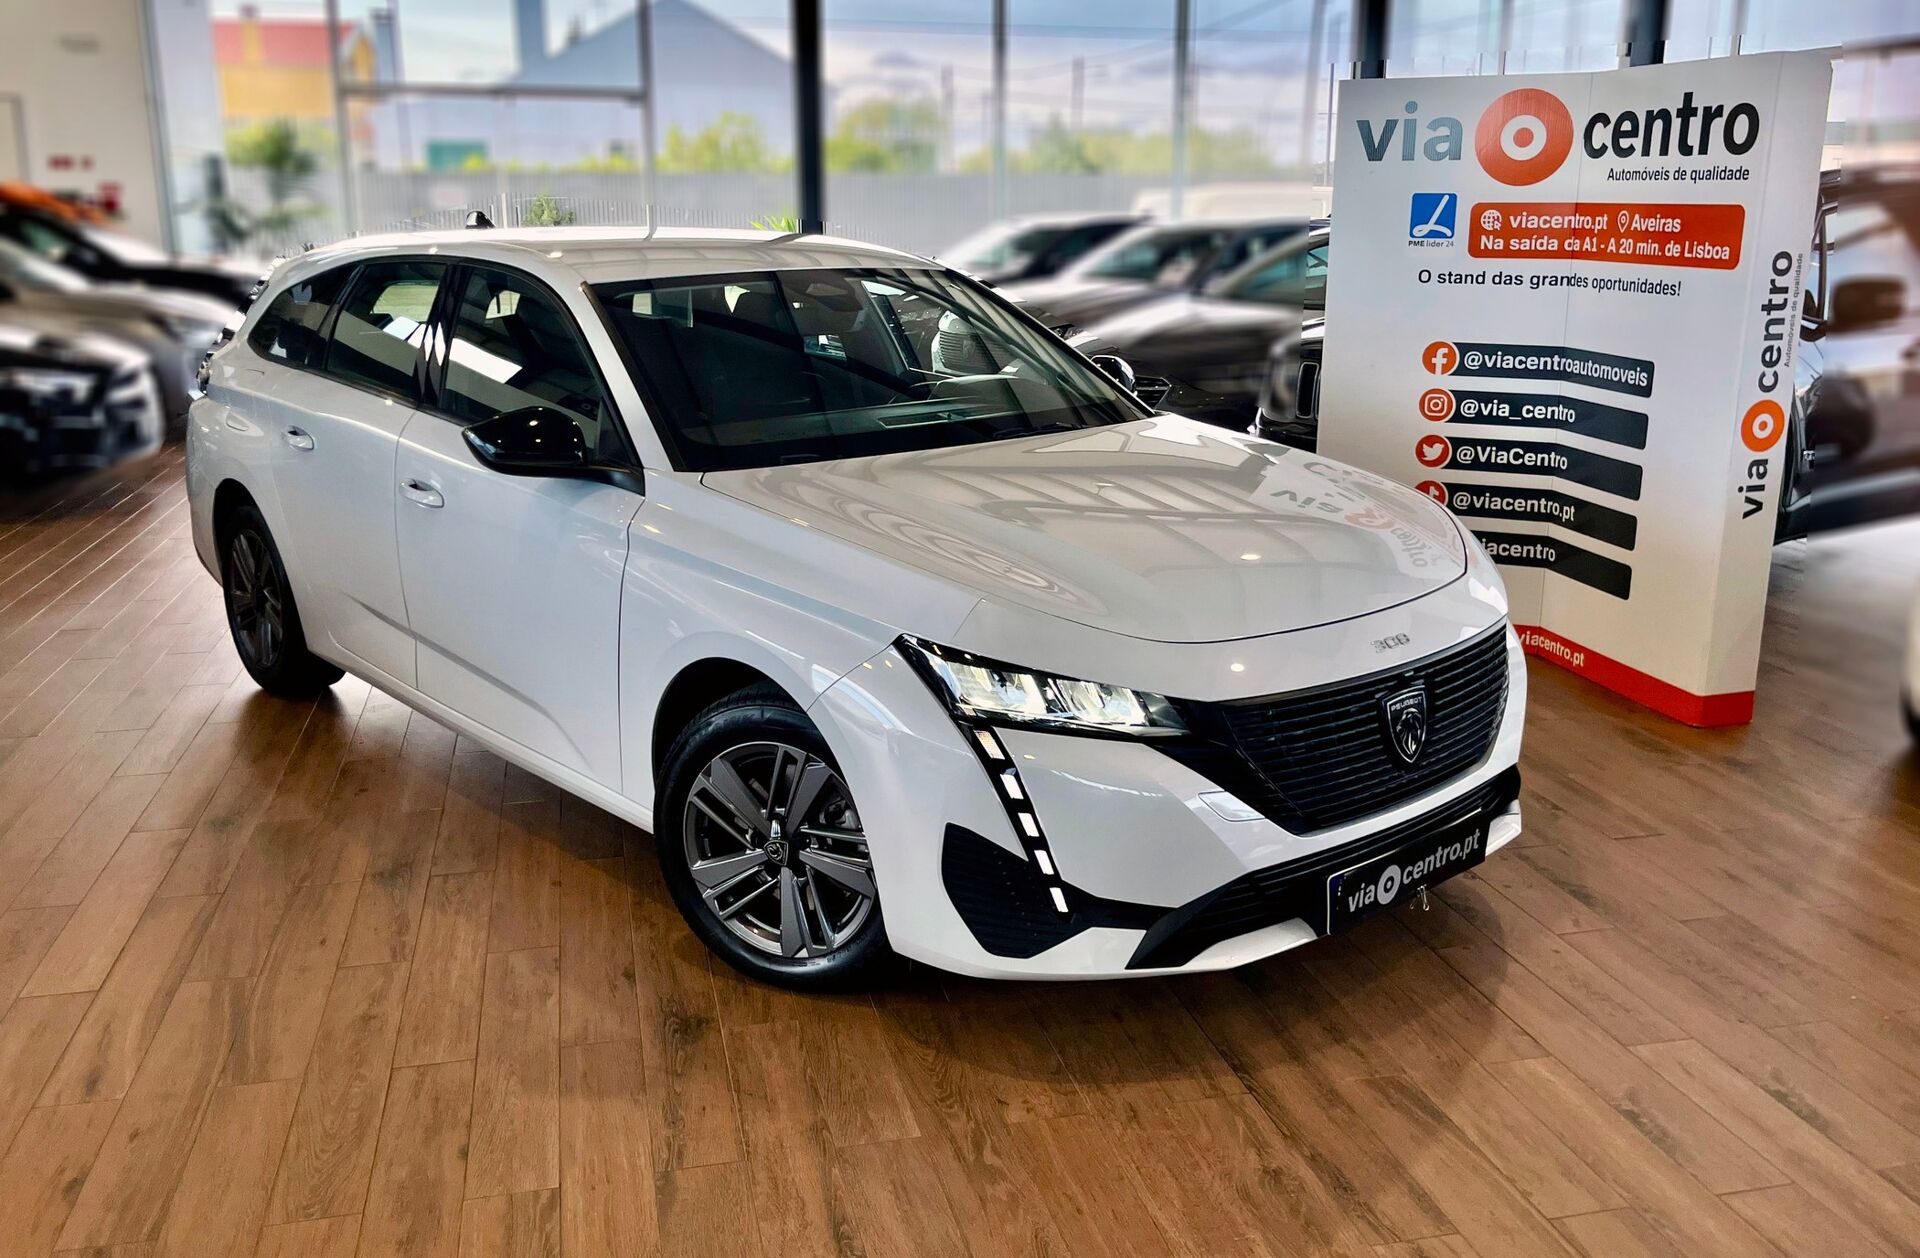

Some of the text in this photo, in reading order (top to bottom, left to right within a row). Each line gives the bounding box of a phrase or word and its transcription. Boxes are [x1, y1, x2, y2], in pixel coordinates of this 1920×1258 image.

[1356, 91, 1761, 162] via centro
[1607, 165, 1750, 184] Automóveis de qualidade
[1509, 211, 1681, 233] viacentro.pt Aveiras
[1480, 235, 1504, 250] Na
[1509, 234, 1558, 251] saída
[1563, 236, 1579, 251] da
[1582, 237, 1598, 252] A1
[1607, 238, 1616, 254] A
[1619, 239, 1634, 254] 20
[1636, 240, 1662, 256] min.
[1665, 241, 1681, 257] de
[1684, 243, 1730, 260] Lisboa
[1418, 269, 1682, 297] O stand das grandes oportunidades!
[1464, 351, 1649, 387] @viacentroautomoveis
[1737, 251, 1793, 520] via centro
[1460, 399, 1576, 423] @via_centro
[1456, 446, 1568, 470] @ViaCentro
[1453, 492, 1575, 522] @viacentro.pt
[1480, 538, 1556, 562] iacentro
[1348, 828, 1480, 913] via centro.pt
